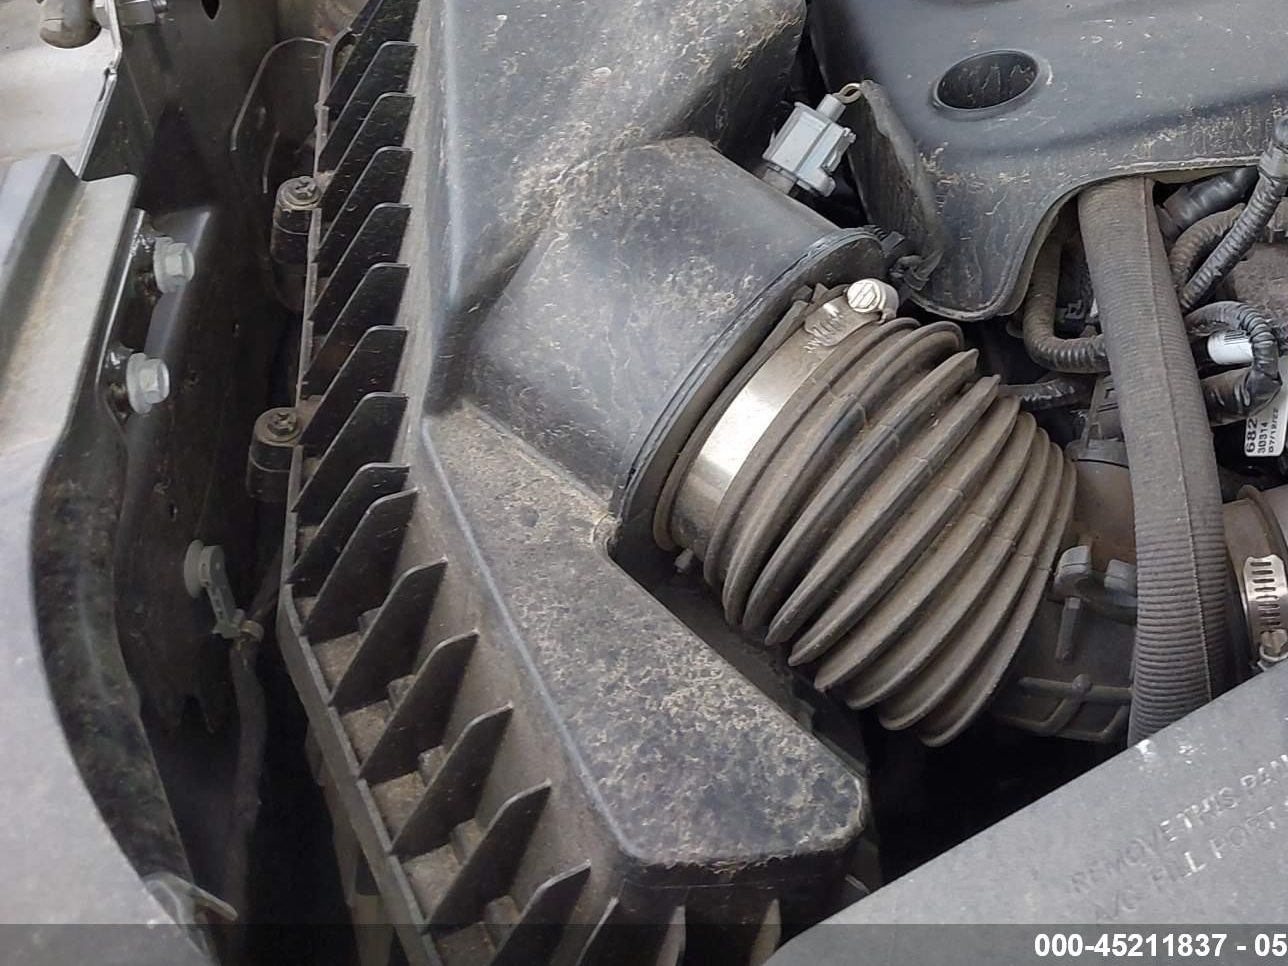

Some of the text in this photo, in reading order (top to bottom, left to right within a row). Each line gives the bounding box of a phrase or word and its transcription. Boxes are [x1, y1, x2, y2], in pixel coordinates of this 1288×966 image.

[1246, 418, 1257, 452] 682
[1181, 786, 1239, 833] THIS
[1210, 805, 1277, 860] PORT
